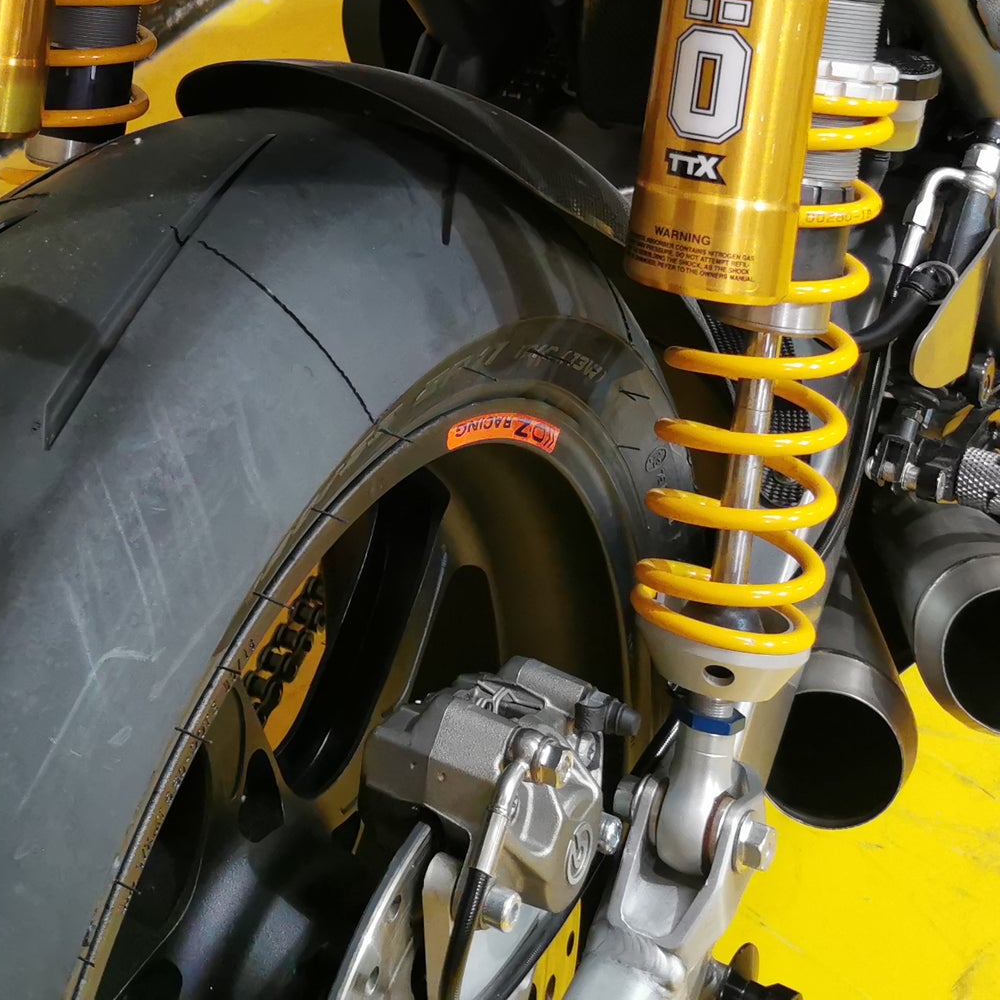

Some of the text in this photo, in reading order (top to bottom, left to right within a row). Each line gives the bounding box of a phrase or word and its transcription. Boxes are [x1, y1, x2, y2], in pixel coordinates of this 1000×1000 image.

[668, 152, 721, 180] TTX
[652, 225, 712, 246] WARNING
[454, 414, 513, 438] RACING
